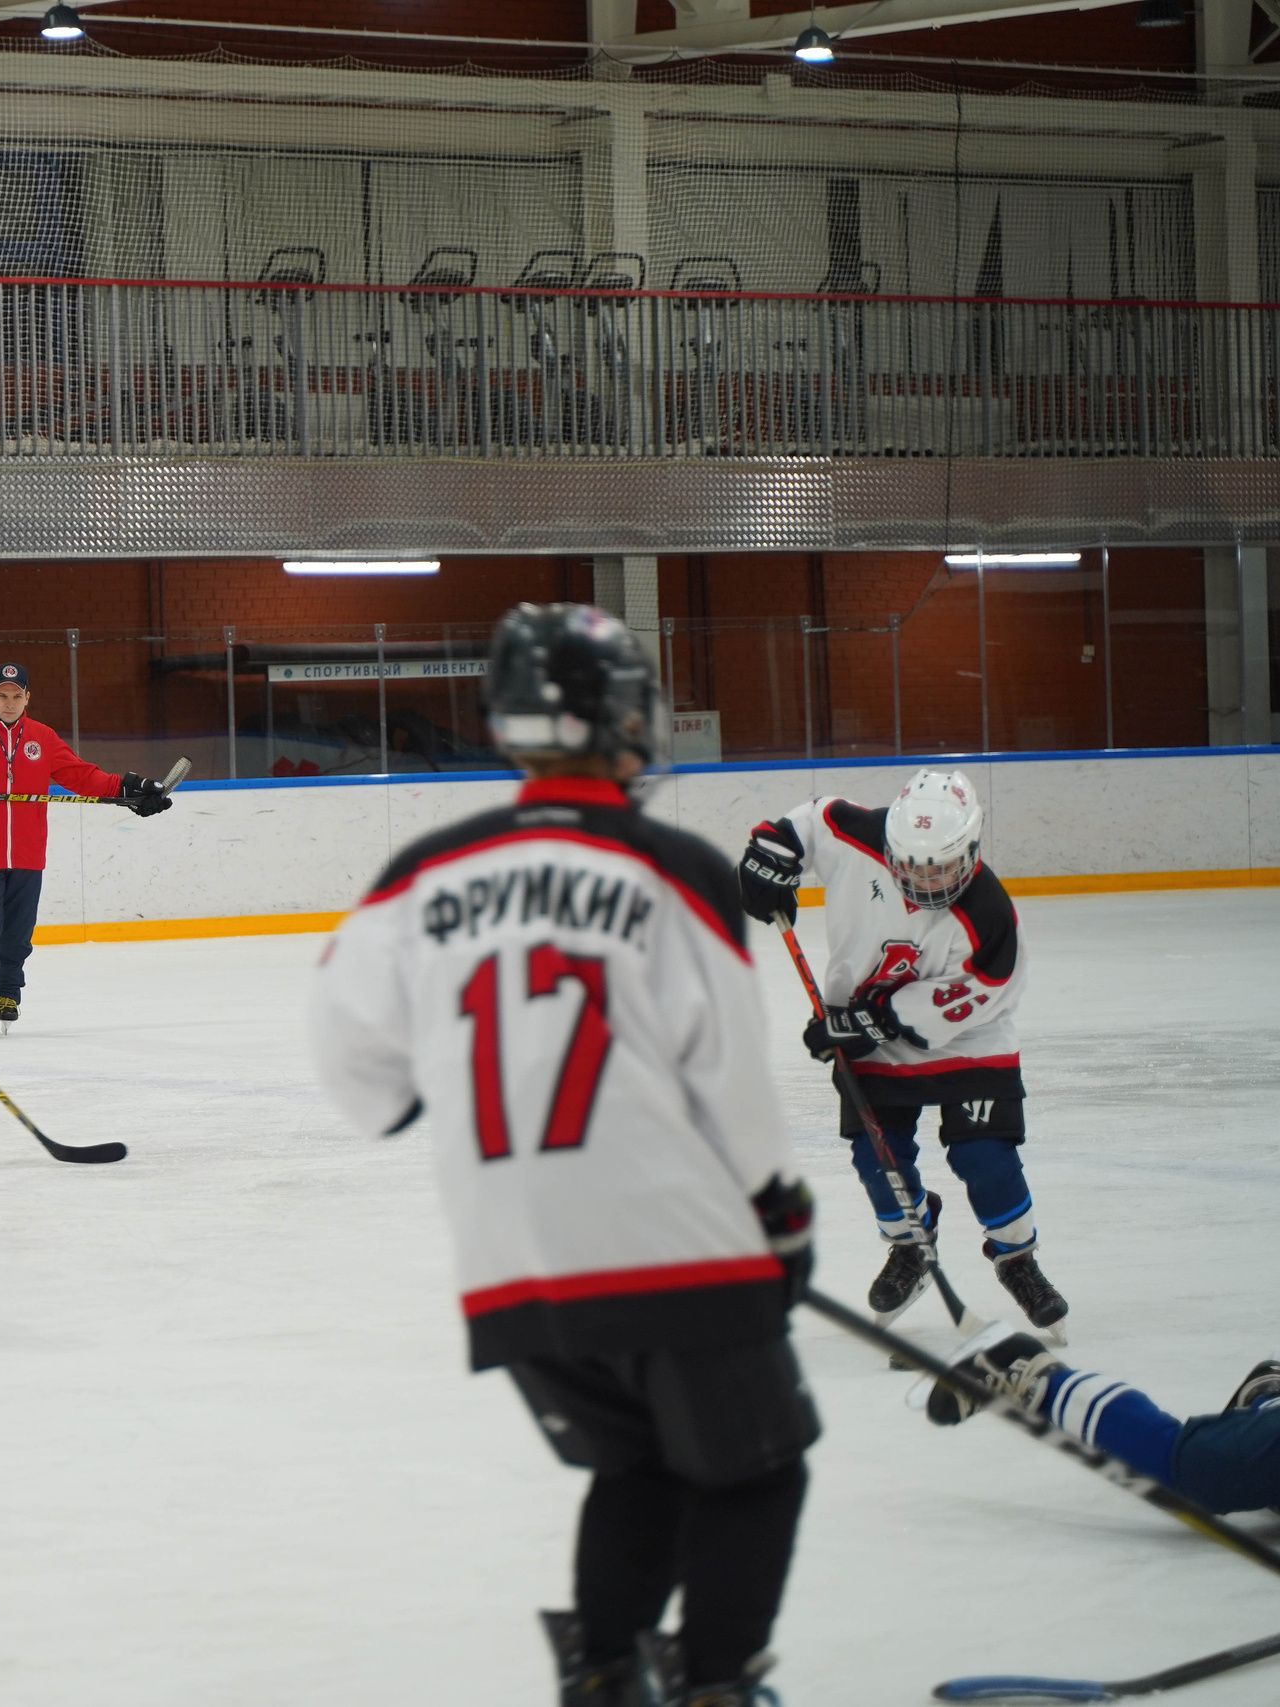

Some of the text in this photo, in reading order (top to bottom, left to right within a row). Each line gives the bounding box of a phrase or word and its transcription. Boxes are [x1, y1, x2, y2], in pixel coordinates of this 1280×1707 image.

[304, 663, 402, 678] СПОРТИВНЫЙ
[38, 794, 100, 804] BAUER
[914, 815, 933, 829] 35
[744, 857, 801, 886] BAUE
[932, 983, 990, 1022] 35
[457, 941, 614, 1161] 17
